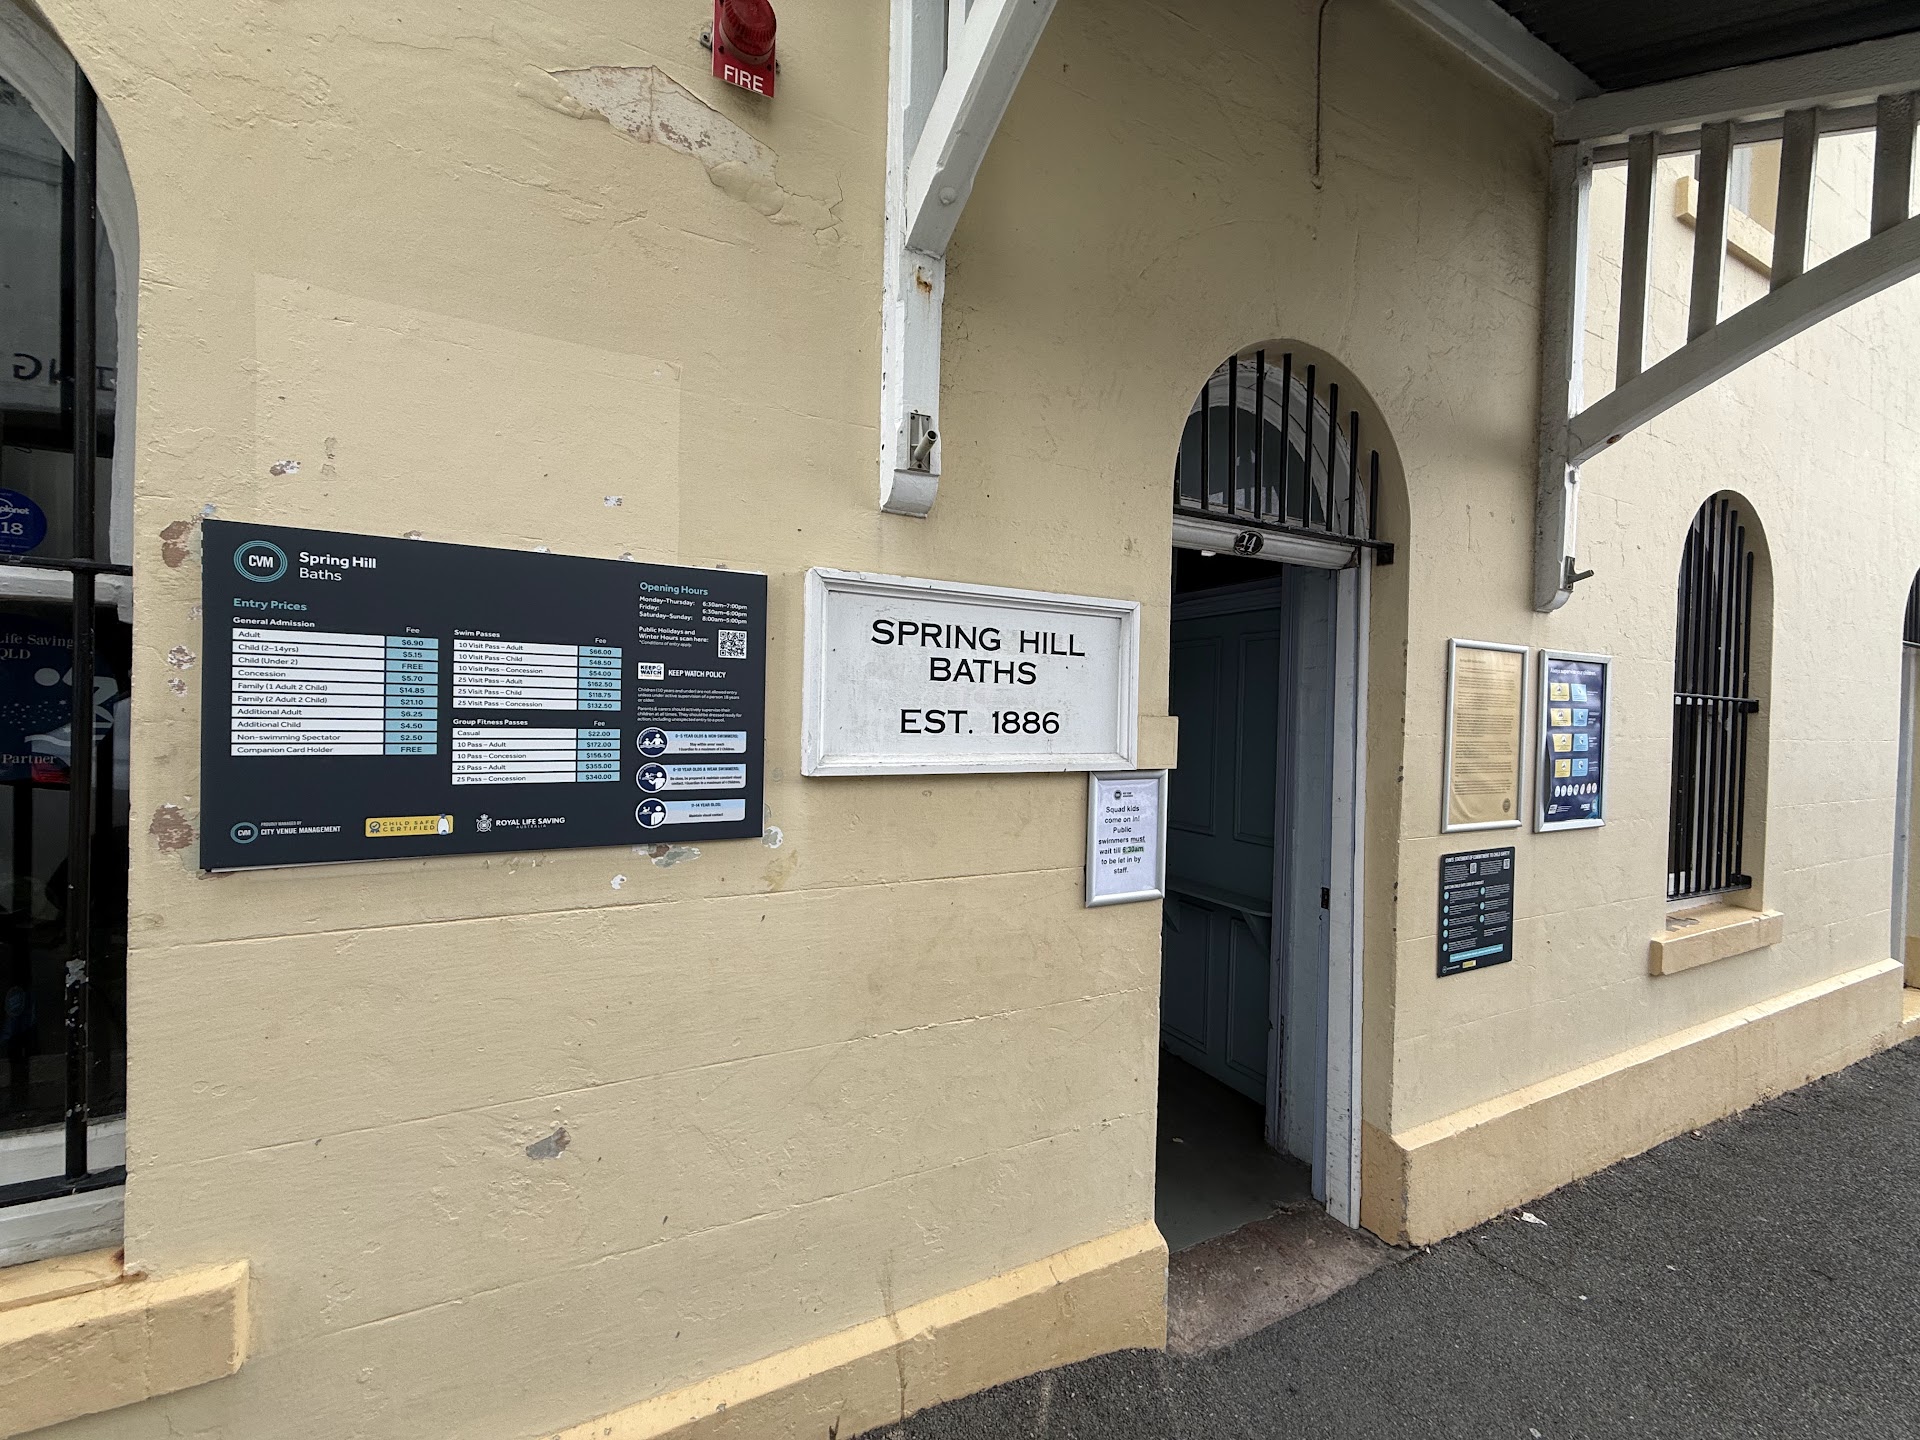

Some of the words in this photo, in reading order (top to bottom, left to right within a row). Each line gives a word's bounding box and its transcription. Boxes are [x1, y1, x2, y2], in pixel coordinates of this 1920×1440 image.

[724, 64, 764, 94] FIRE
[248, 554, 274, 568] CVM
[299, 551, 350, 569] Spring
[352, 554, 377, 569] Hill
[299, 567, 342, 581] Baths
[640, 582, 680, 595] Opening
[681, 585, 709, 596] Hours
[233, 598, 268, 611] Entry
[270, 599, 307, 611] Prices
[232, 616, 269, 626] General
[270, 618, 315, 628] Admission
[405, 626, 420, 634] Fee
[454, 629, 474, 637] Swim
[476, 630, 500, 638] Passes
[658, 628, 684, 636] Holidays
[27, 634, 74, 649] Saving
[871, 619, 1001, 651] SPRING
[1019, 630, 1086, 657] HILL
[238, 643, 260, 651] Child
[238, 656, 260, 664] Child
[261, 657, 288, 665] (Under
[469, 653, 483, 661] Visit
[238, 669, 286, 677] Concession
[668, 669, 684, 677] KEEP
[705, 670, 727, 678] POLICY
[929, 657, 1037, 685] BATHS
[237, 683, 264, 691] Family
[275, 683, 297, 691] Adult
[237, 695, 264, 703] Family
[400, 698, 424, 706] $21.10
[453, 718, 476, 726] Group
[900, 709, 973, 734] EST.
[992, 711, 1060, 735] 1886
[237, 734, 300, 742] Non-swimming
[237, 746, 285, 754] Companion
[2, 754, 56, 764] Partner
[1105, 806, 1126, 814] Squad
[495, 818, 521, 827] ROYAL
[522, 818, 536, 826] LIFE
[537, 817, 566, 825] SAVING
[276, 827, 298, 835] VENUE
[298, 826, 341, 834] MANAGEMENT
[1098, 837, 1129, 845] swimmers
[1133, 856, 1141, 864] by
